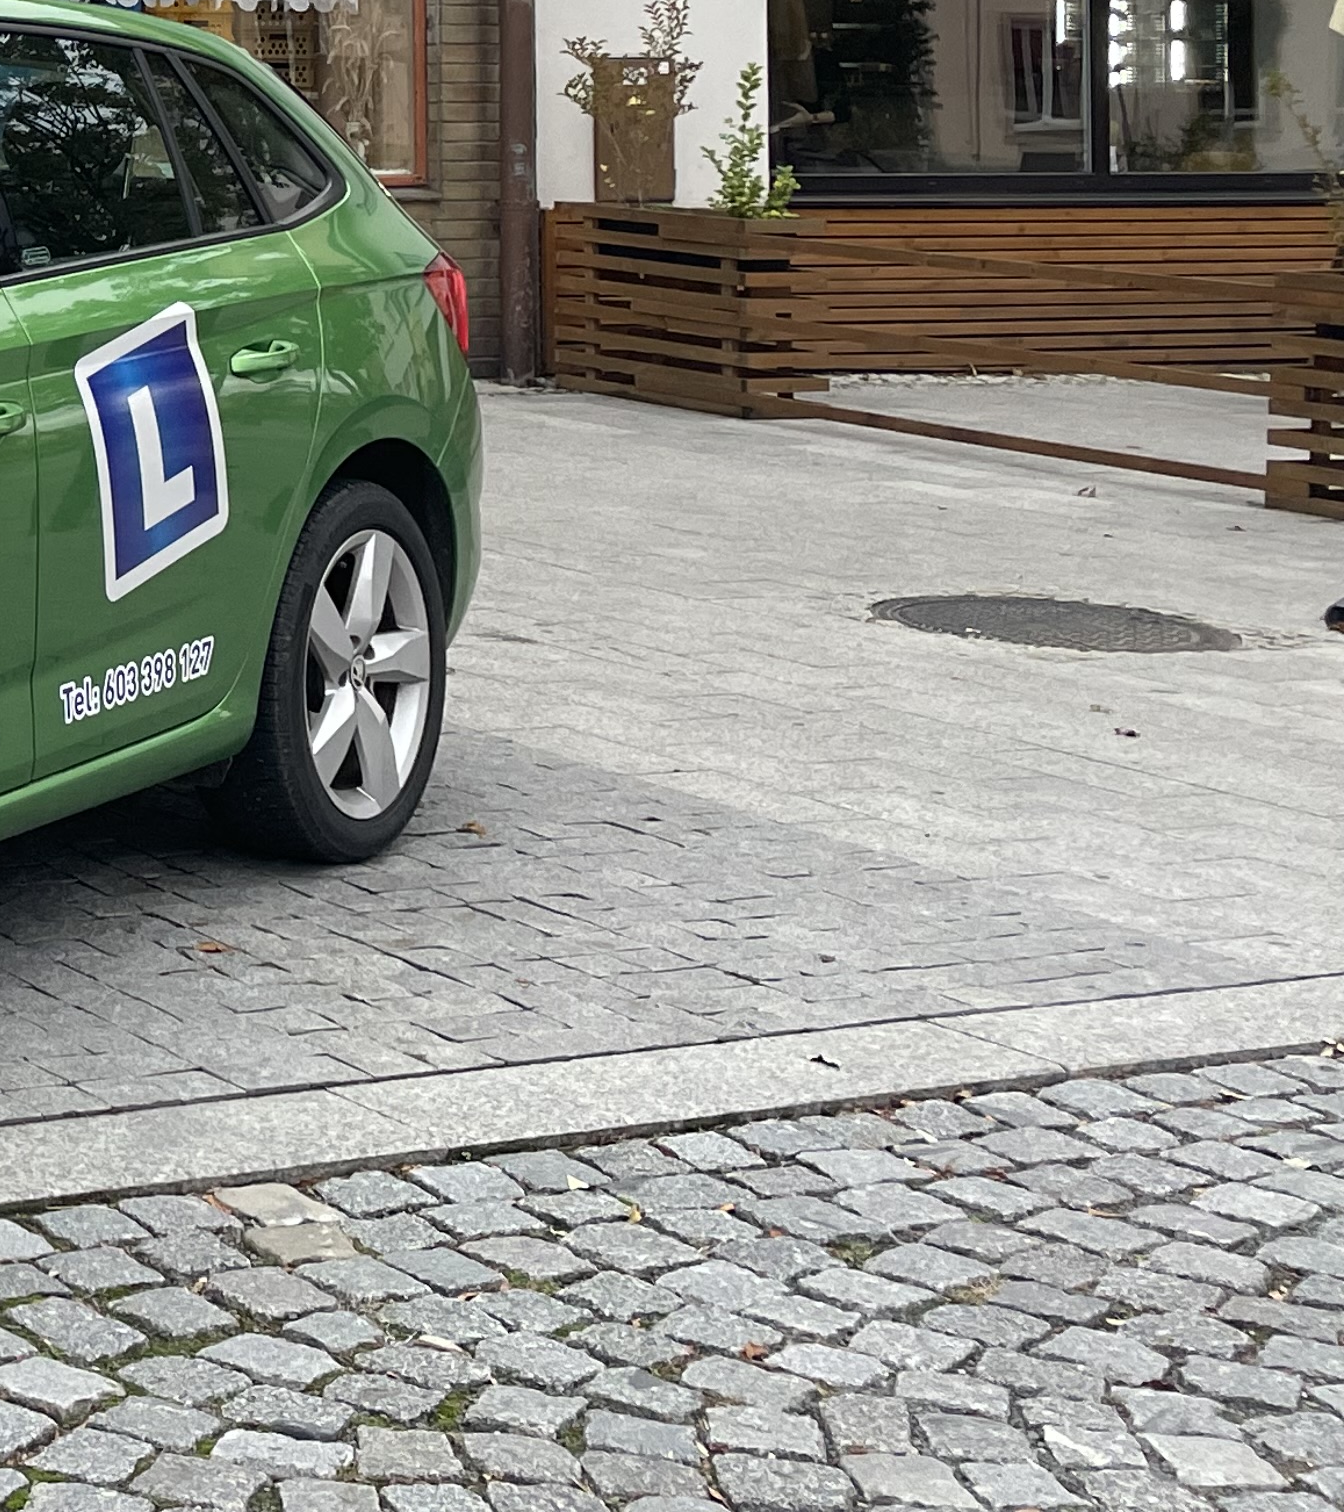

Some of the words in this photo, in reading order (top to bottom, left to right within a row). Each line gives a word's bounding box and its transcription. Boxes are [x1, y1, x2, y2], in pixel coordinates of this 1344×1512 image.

[127, 386, 195, 531] L
[62, 680, 99, 720] Tel:
[104, 665, 137, 705] 603
[141, 653, 174, 692] 398
[180, 640, 212, 678] 127
